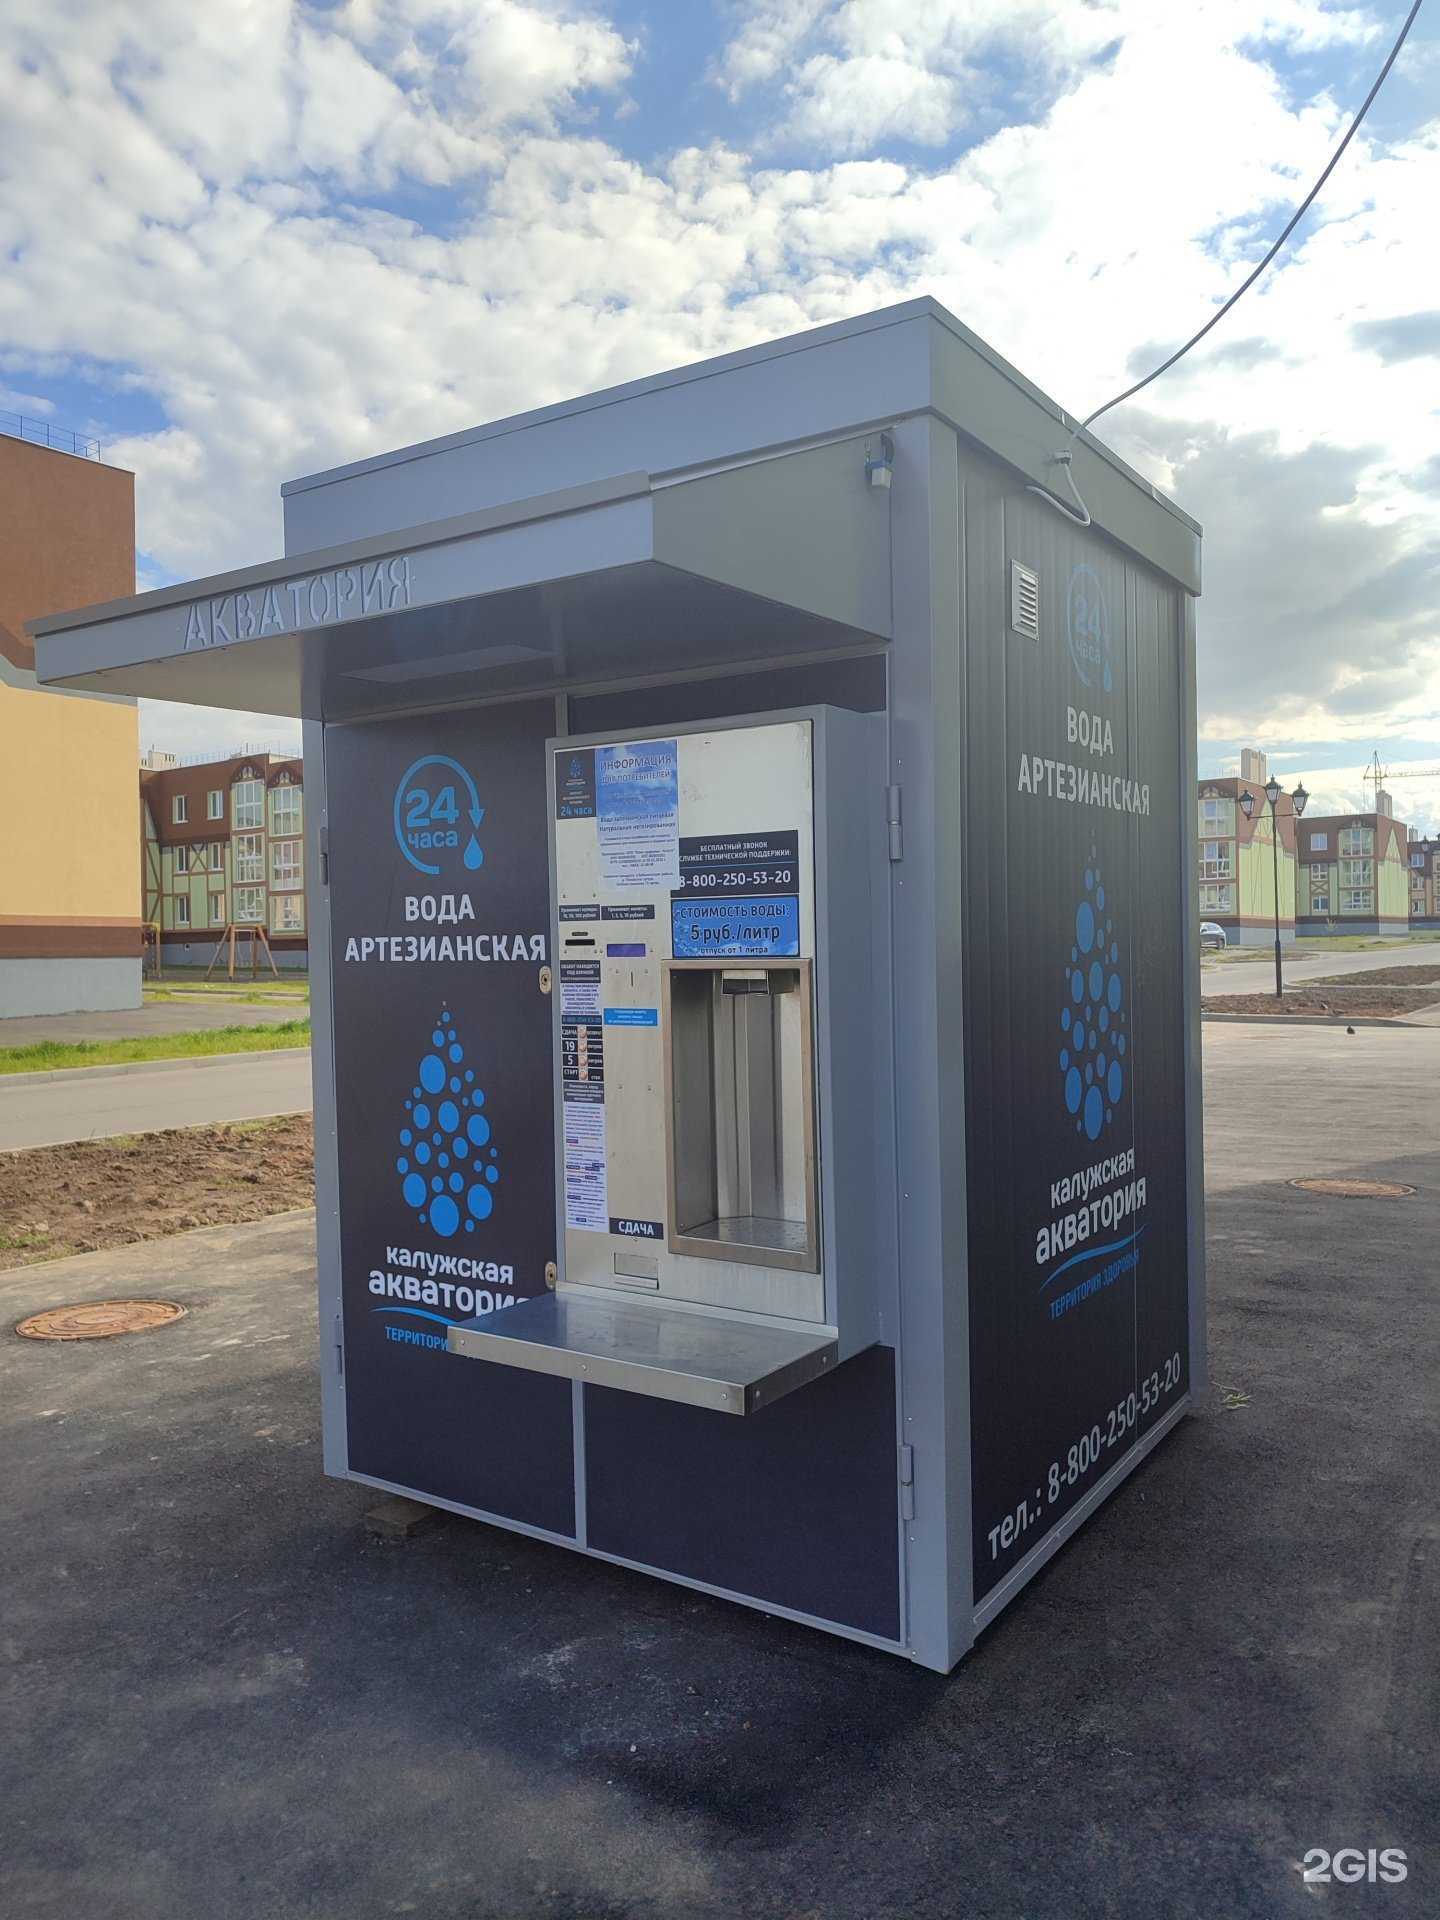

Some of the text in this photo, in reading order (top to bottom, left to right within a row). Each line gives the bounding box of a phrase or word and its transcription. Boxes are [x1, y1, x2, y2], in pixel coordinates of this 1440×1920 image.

[183, 556, 411, 650] АКВАТОРИЯ
[1067, 705, 1114, 757] ВОДА
[600, 754, 672, 771] ИНФОРМАЦИЯ
[1018, 753, 1150, 816] АРТЕЗИАНСКАЯ
[406, 786, 460, 828] 24
[408, 829, 459, 849] часа
[700, 841, 768, 852] БЕСПЛАТНЫЙ ЗВОНОК
[705, 852, 748, 861] ТЕХНИЧЕСКОЙ
[680, 870, 791, 888] 8-800-250-53-20
[405, 894, 476, 924] ВОДА
[680, 905, 748, 919] СТОИМОСТЬ
[344, 934, 546, 962] АРТЕЗИАНСКАЯ
[565, 1041, 575, 1051] 19
[567, 1055, 573, 1065] 5
[1051, 1148, 1135, 1209] калужская
[618, 1220, 655, 1236] СДАЧА
[1036, 1177, 1147, 1265] акватория
[386, 1246, 514, 1285] калужская
[368, 1270, 530, 1317] акватори
[988, 1352, 1181, 1560] тел.: 8-800-250-53-20
